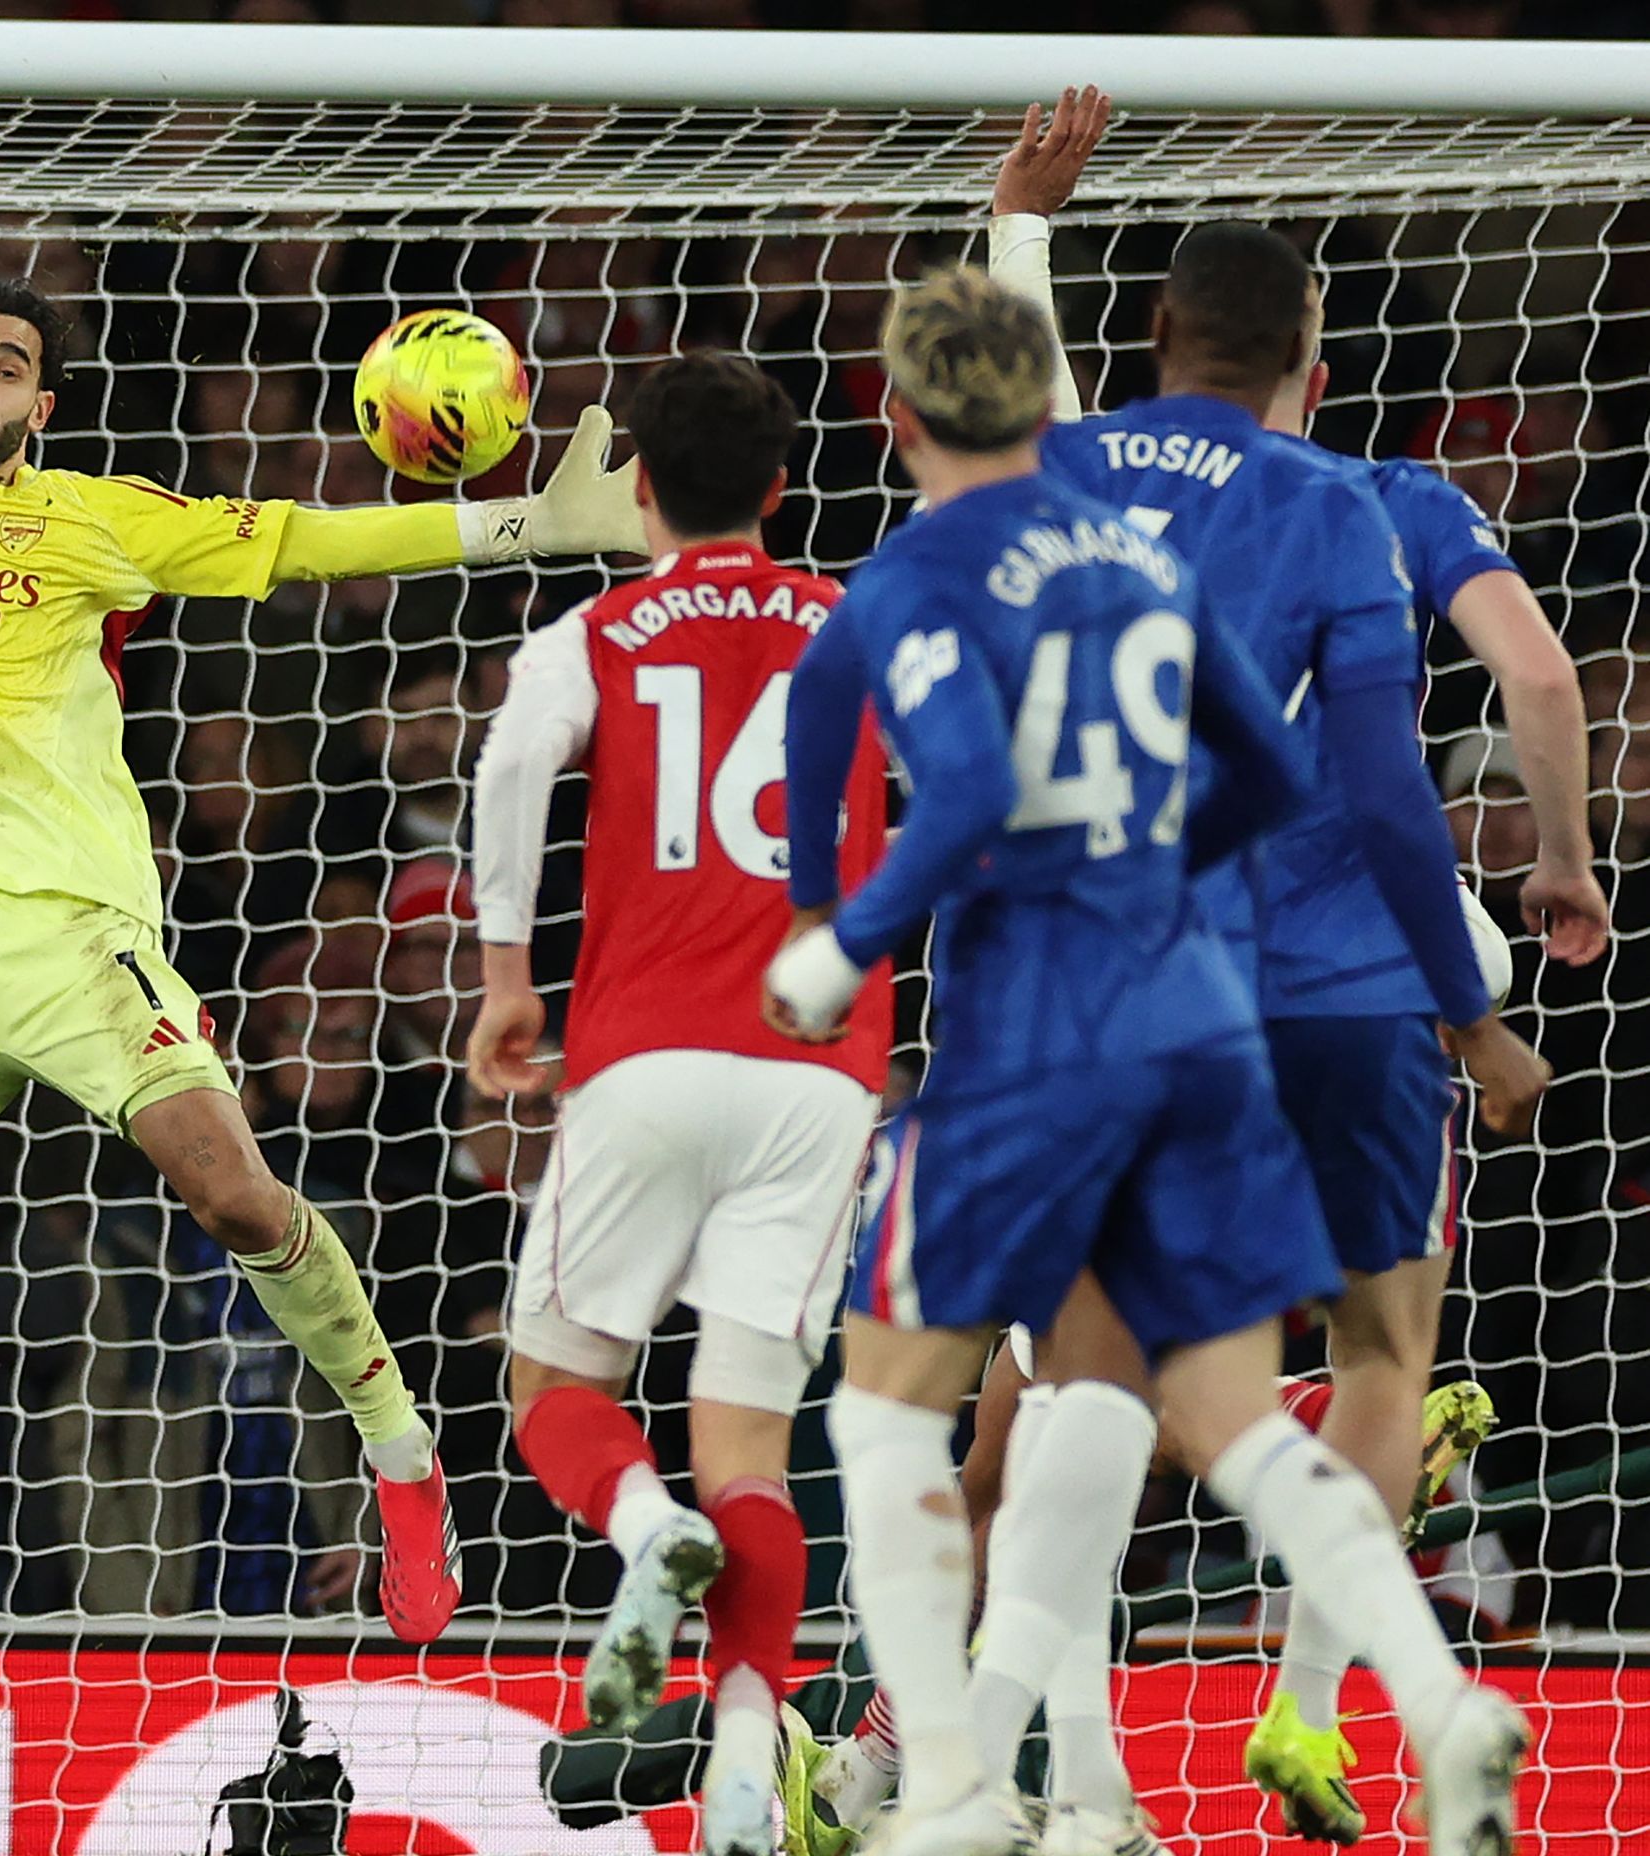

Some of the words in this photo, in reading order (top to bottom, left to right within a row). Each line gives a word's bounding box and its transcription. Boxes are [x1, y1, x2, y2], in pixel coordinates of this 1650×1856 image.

[1097, 430, 1243, 489] TOSIN
[601, 584, 830, 652] NØRGAAR
[1004, 608, 1197, 860] 49
[635, 664, 793, 880] 16
[115, 950, 163, 1010] 1
